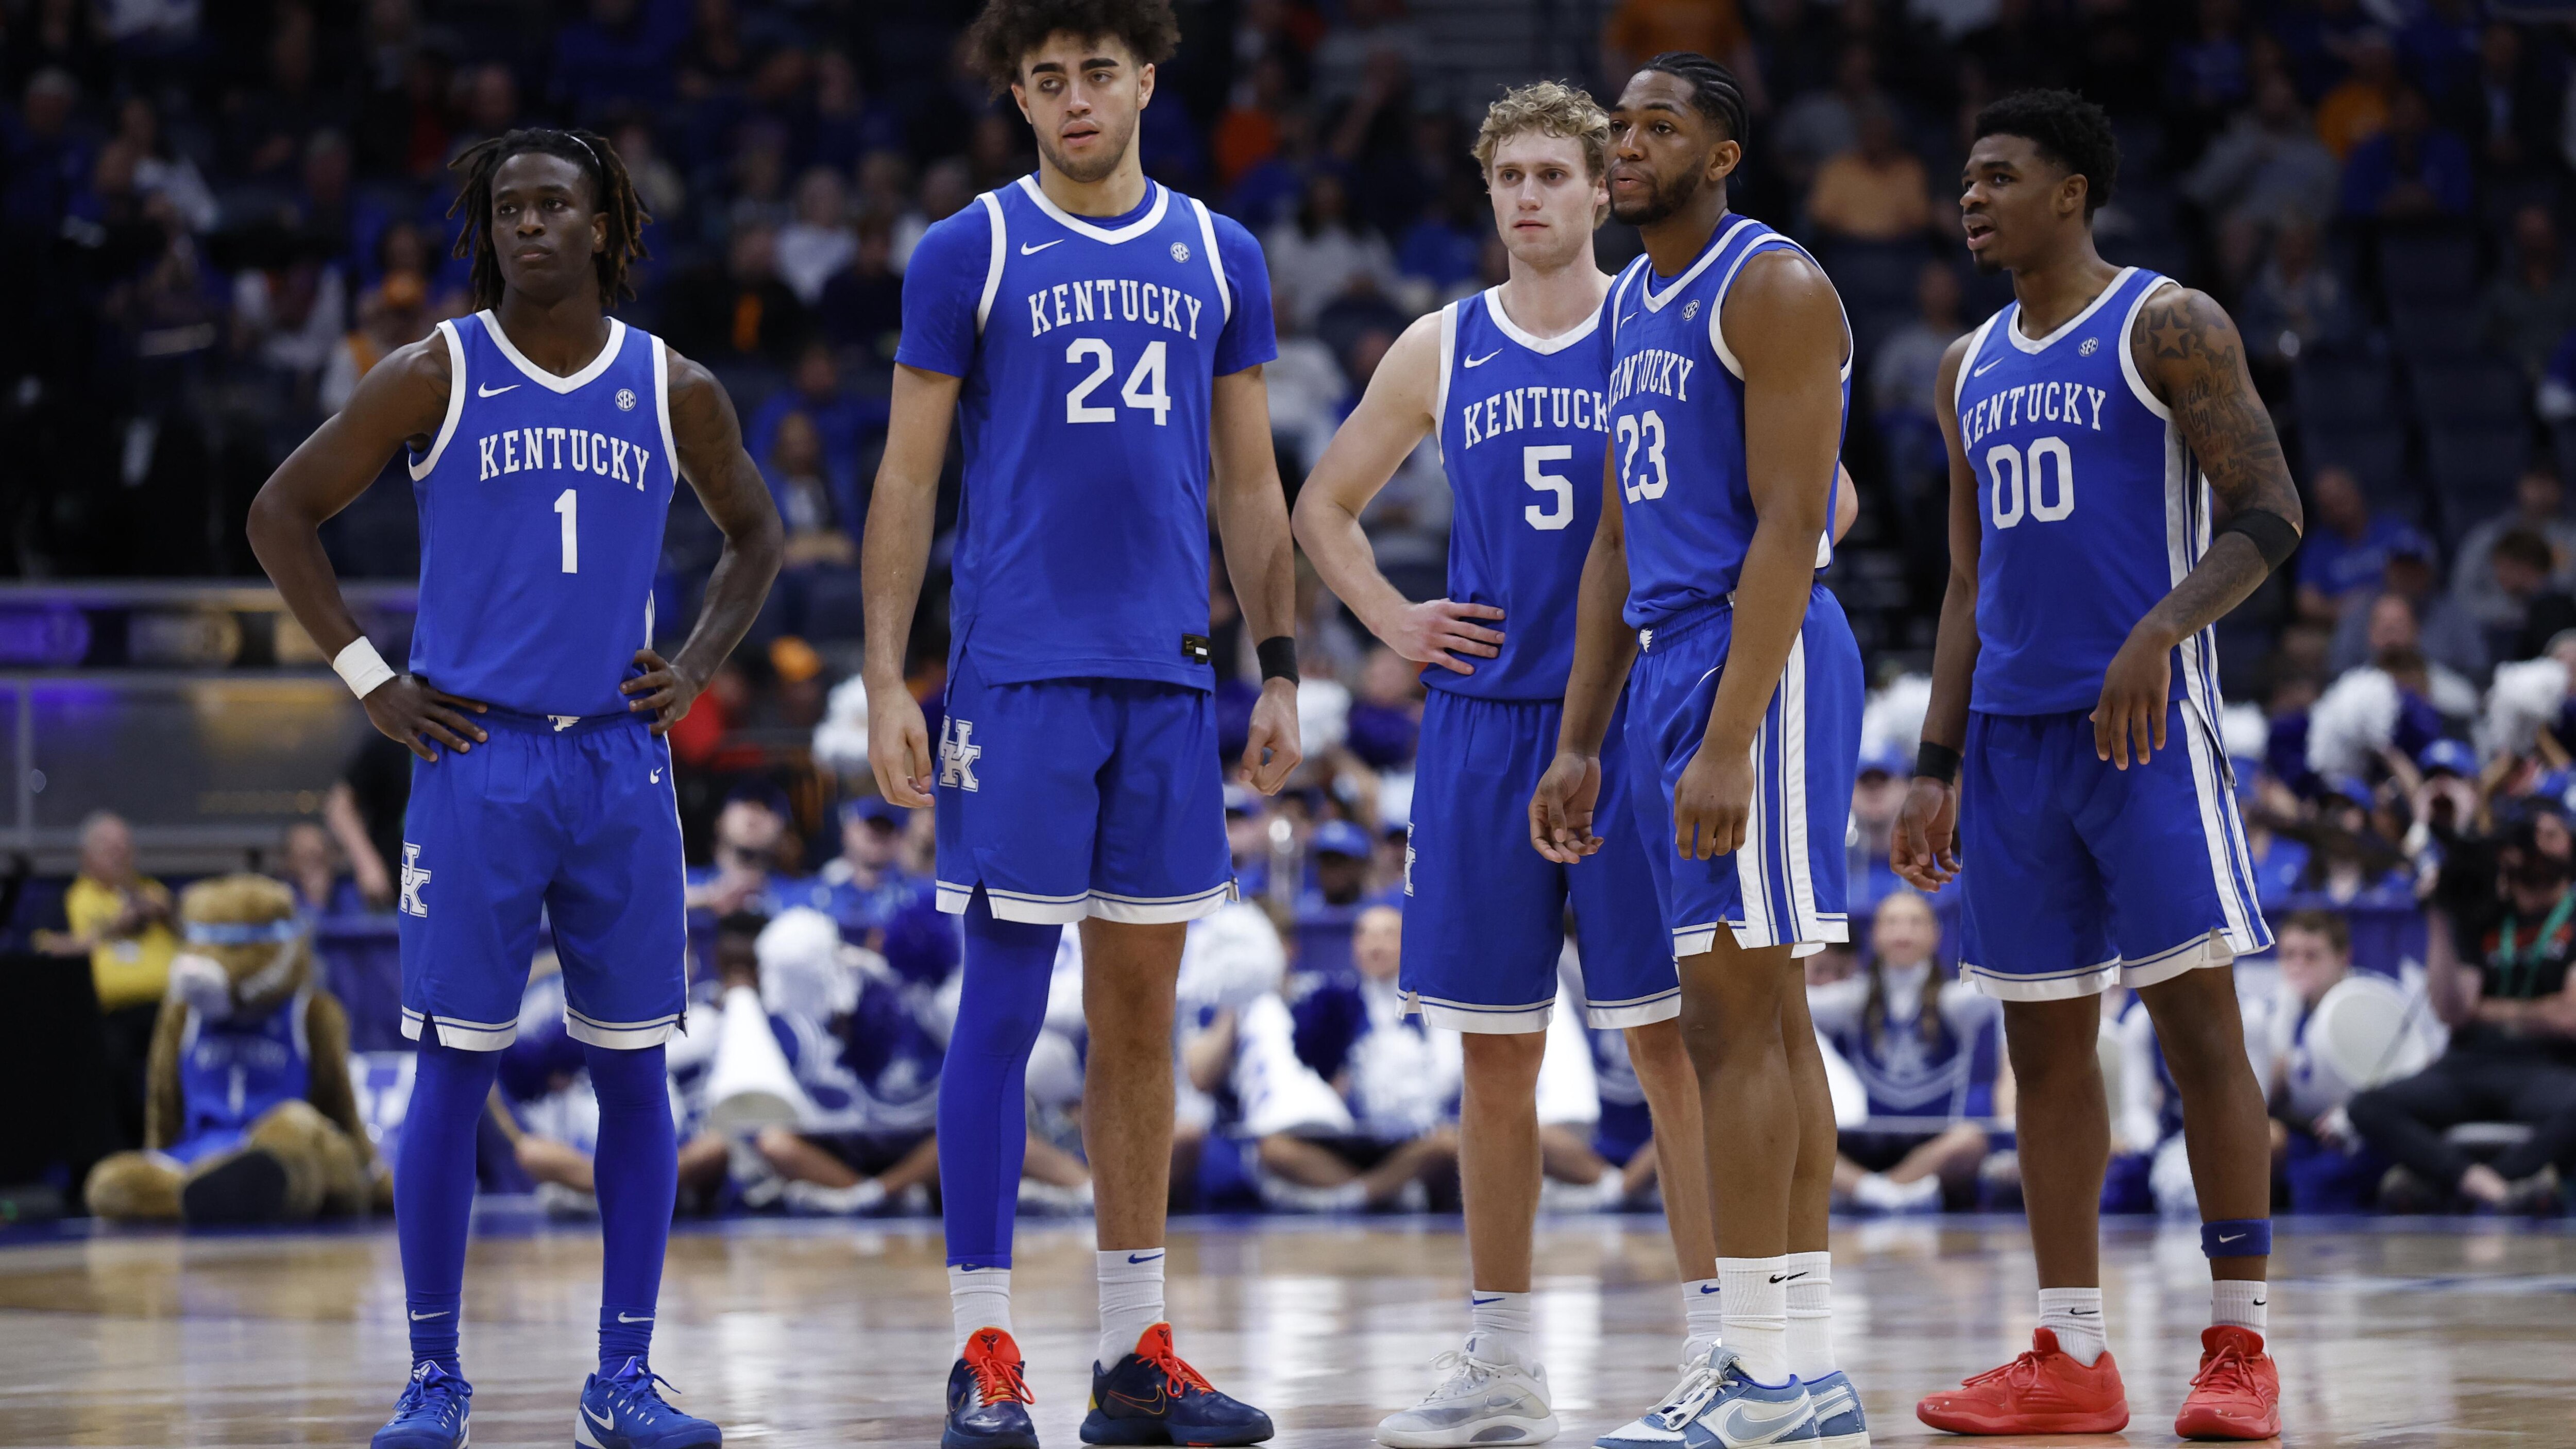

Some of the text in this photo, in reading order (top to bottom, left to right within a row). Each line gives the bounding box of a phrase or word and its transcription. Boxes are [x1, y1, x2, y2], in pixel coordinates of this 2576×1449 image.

[1173, 244, 1189, 261] SEC
[1028, 280, 1201, 340] KENTUCKY
[1684, 301, 1698, 319] SEC
[2080, 338, 2097, 355] SEC
[617, 390, 634, 409] SEC
[1066, 338, 1171, 426] 24
[1963, 382, 2106, 456] KENTUCKY
[480, 428, 649, 491] KENTUCKY
[1524, 445, 1573, 530] 5
[1617, 410, 1668, 504] 23
[1987, 436, 2074, 530] 00
[554, 489, 577, 573] 1
